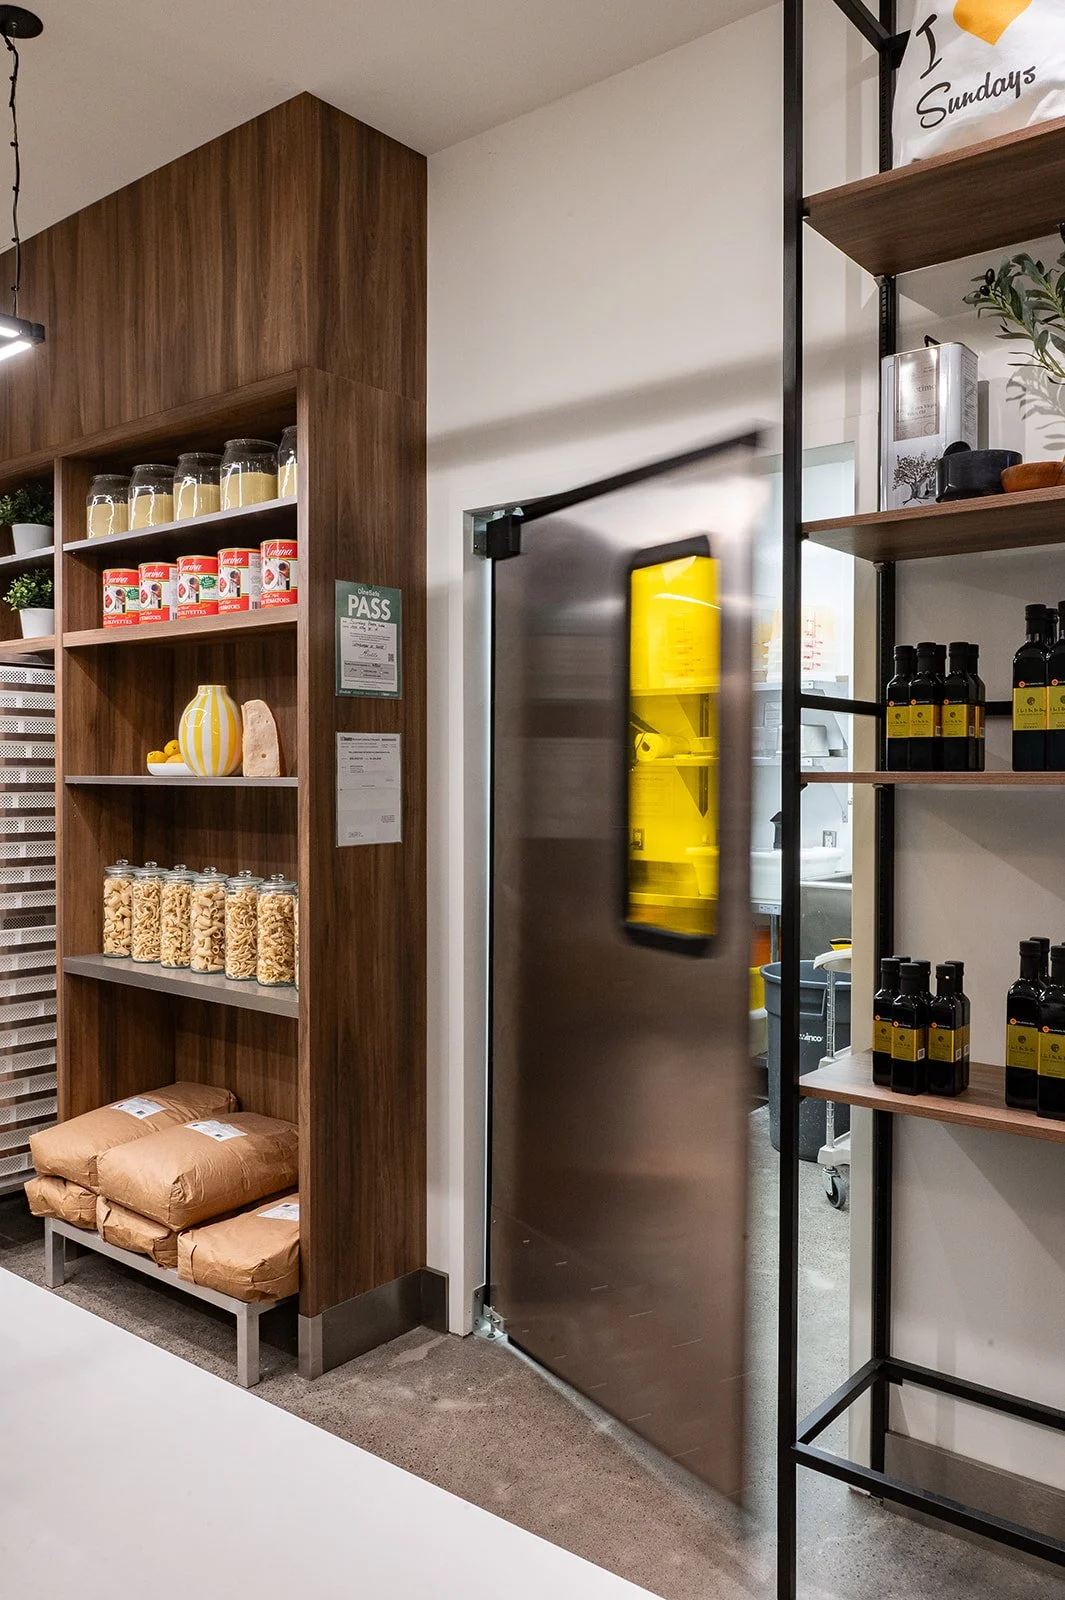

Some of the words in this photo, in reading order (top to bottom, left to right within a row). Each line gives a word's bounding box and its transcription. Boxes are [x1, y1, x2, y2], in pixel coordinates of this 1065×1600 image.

[916, 14, 942, 79] I
[916, 66, 1036, 128] Sundays
[348, 594, 391, 621] PASS
